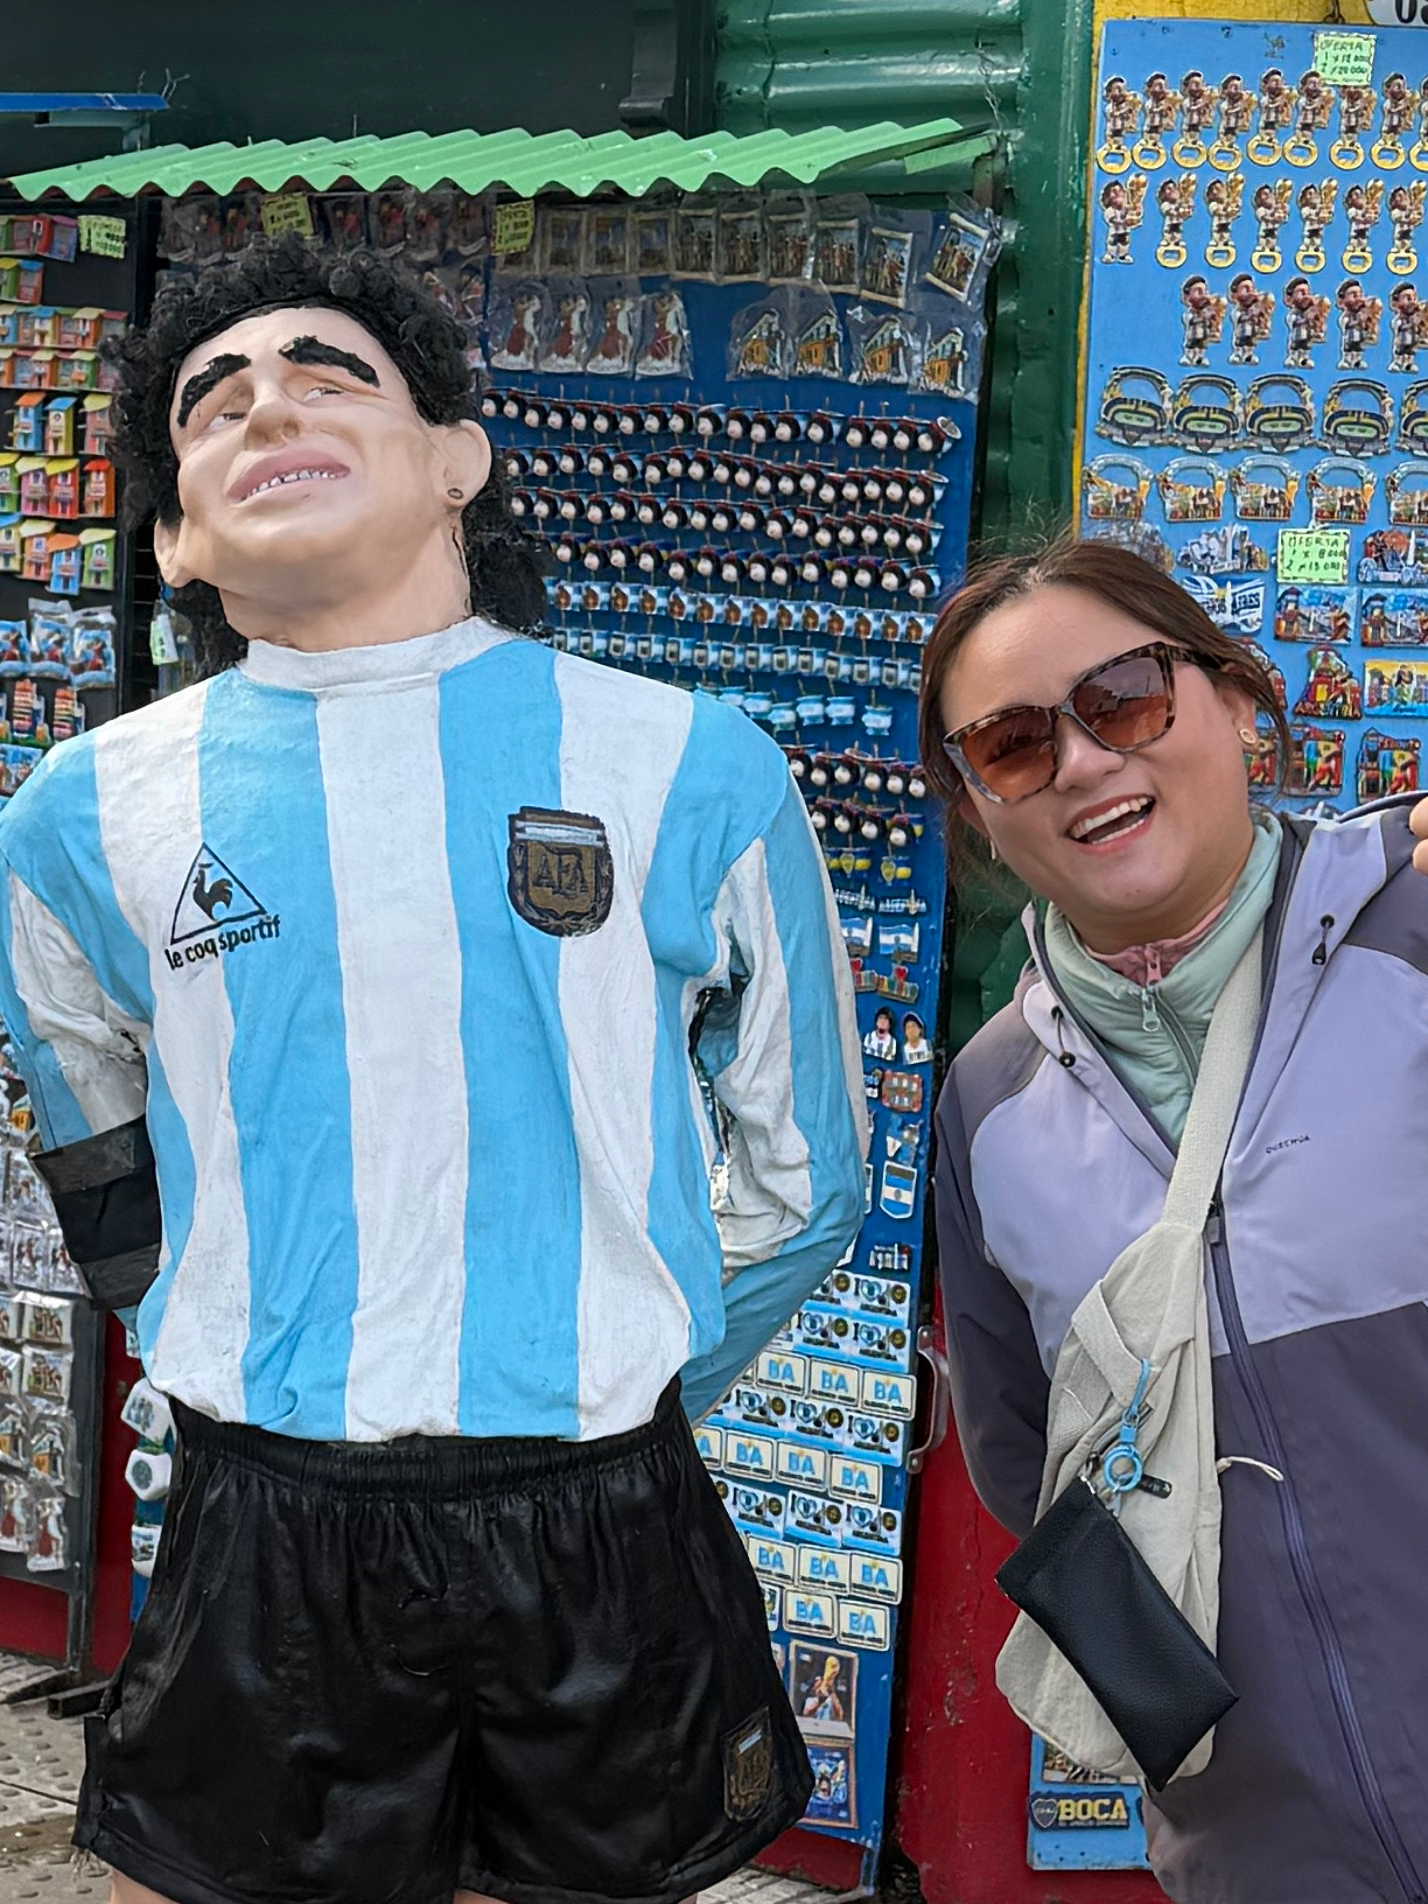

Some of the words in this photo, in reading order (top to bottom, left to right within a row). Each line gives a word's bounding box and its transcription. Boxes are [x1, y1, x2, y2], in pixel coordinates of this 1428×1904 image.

[164, 948, 184, 971] le
[184, 938, 219, 964] coq
[217, 914, 281, 954] sportif
[768, 1358, 796, 1383] BA
[820, 1369, 850, 1393] BA
[874, 1379, 903, 1403] BA
[735, 1442, 763, 1466] BA
[788, 1452, 815, 1476] BA
[841, 1466, 869, 1488] BA
[758, 1545, 785, 1569] BA
[809, 1556, 839, 1579] BA
[861, 1564, 890, 1587] BA
[795, 1600, 825, 1622] BA
[849, 1611, 877, 1634] BA
[1057, 1798, 1128, 1821] BOCA
